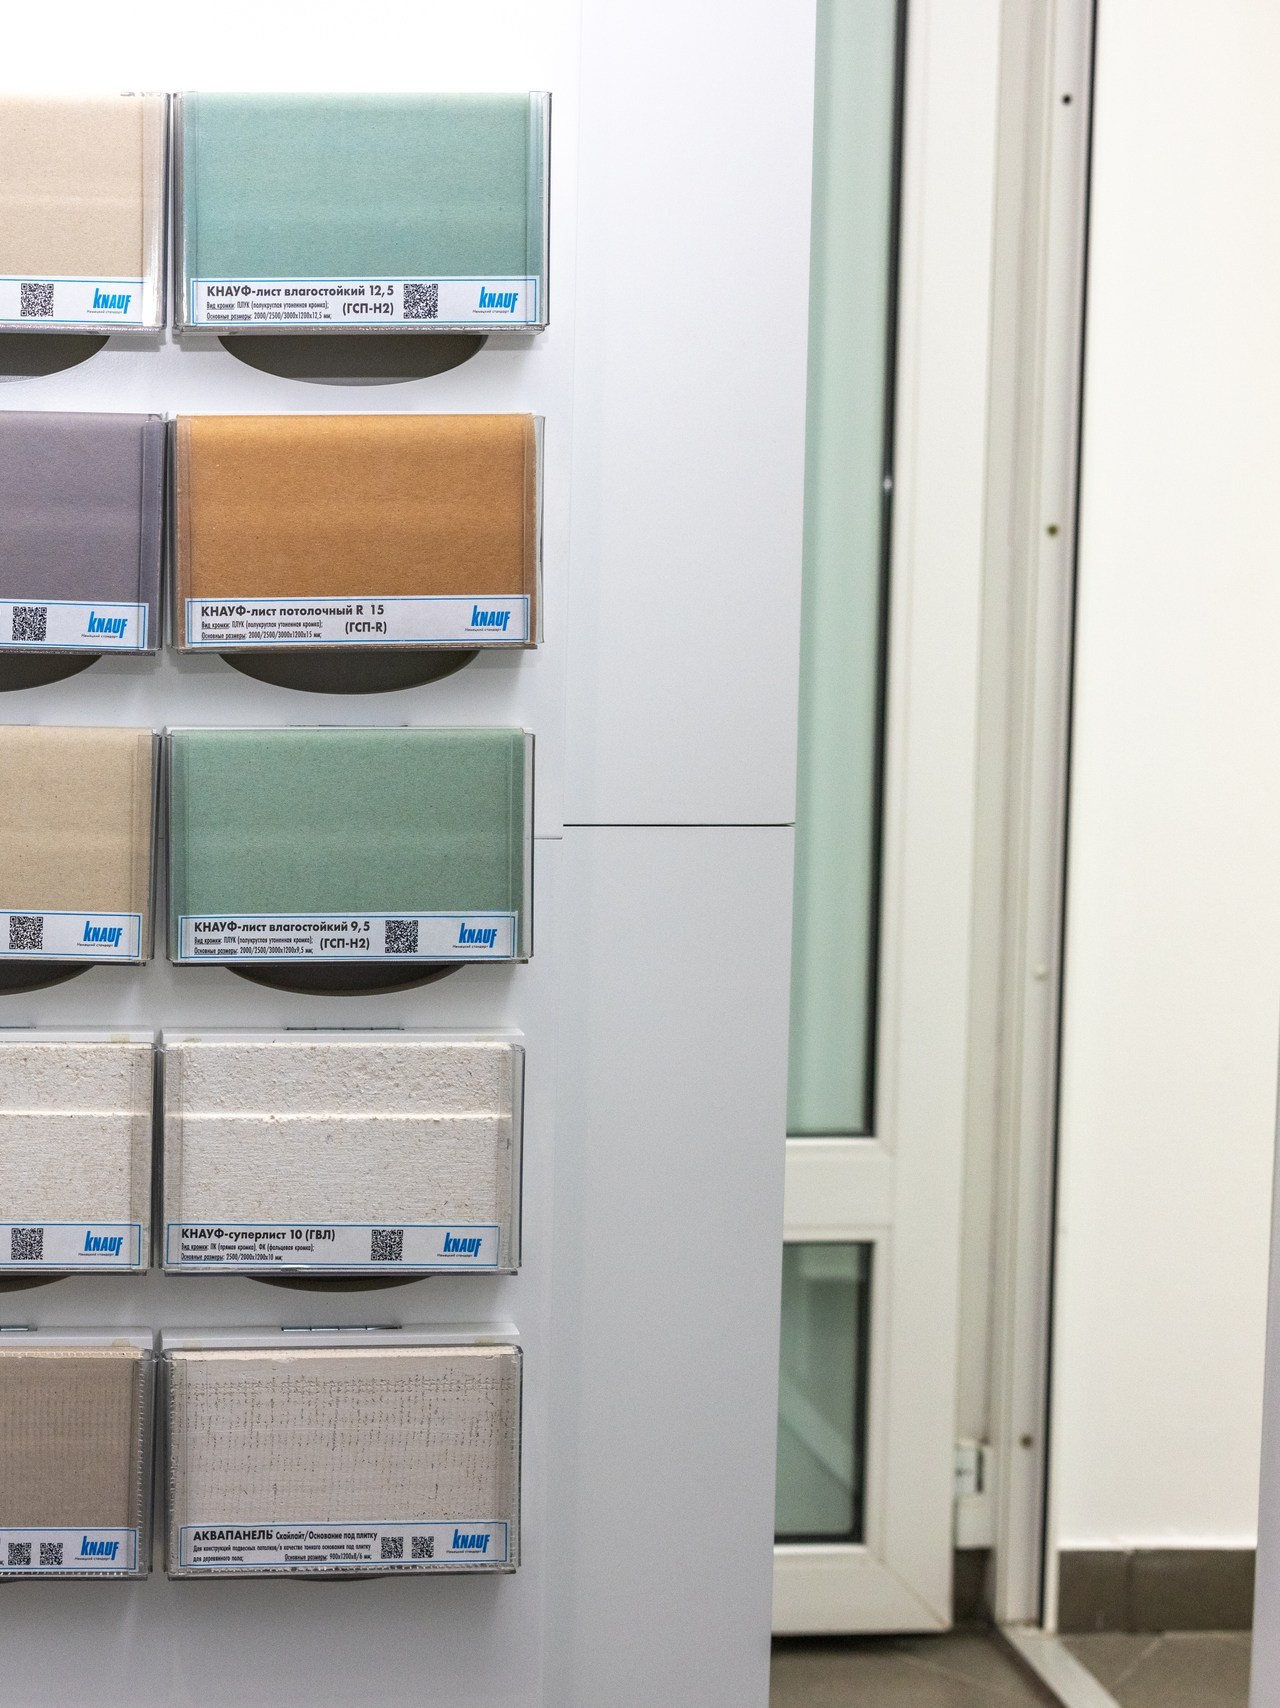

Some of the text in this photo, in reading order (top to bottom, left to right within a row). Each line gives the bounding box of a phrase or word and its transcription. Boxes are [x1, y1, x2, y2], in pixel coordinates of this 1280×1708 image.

[207, 285, 281, 296] КНАУФ-лист
[284, 286, 365, 296] влагостойкий
[201, 605, 384, 616] КНАУФ-лист потолочный R 15
[345, 621, 386, 634] (ГСП-R)
[194, 921, 266, 932] КНАУФ-лист
[269, 922, 347, 931] влагостойкий
[181, 1228, 335, 1242] КНАУФ-суперлист 10 (ГВЛ)
[275, 1531, 342, 1541] Скайлайт/Основание
[356, 1533, 377, 1541] плитку
